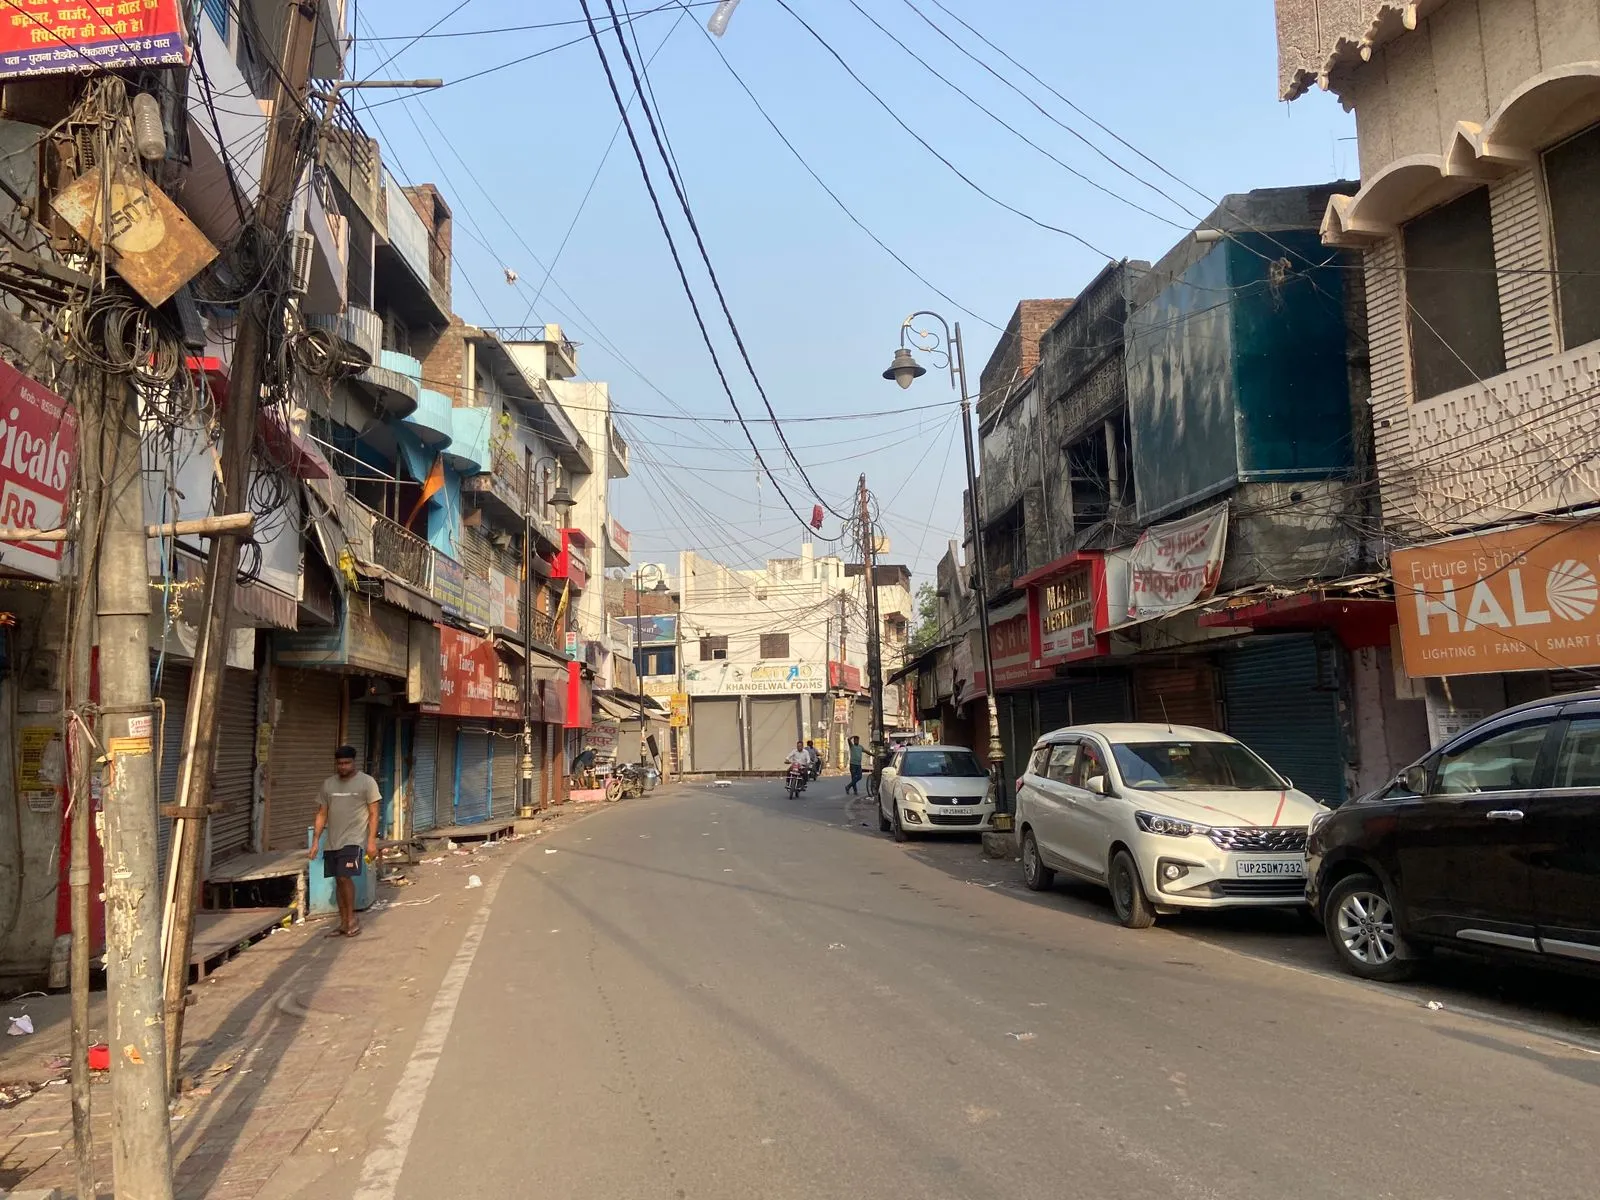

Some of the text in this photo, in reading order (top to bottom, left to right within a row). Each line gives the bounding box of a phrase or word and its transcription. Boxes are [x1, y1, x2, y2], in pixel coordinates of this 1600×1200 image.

[80, 23, 97, 38] की
[153, 38, 170, 48] पास
[0, 408, 70, 491] icals
[1411, 546, 1528, 582] Future is this
[1422, 644, 1477, 660] LIGHTING
[1495, 641, 1528, 655] FANS
[1546, 635, 1591, 650] SMART
[726, 680, 823, 692] KHANDELWAL FOAMS
[1244, 863, 1302, 873] UP25DM7332
